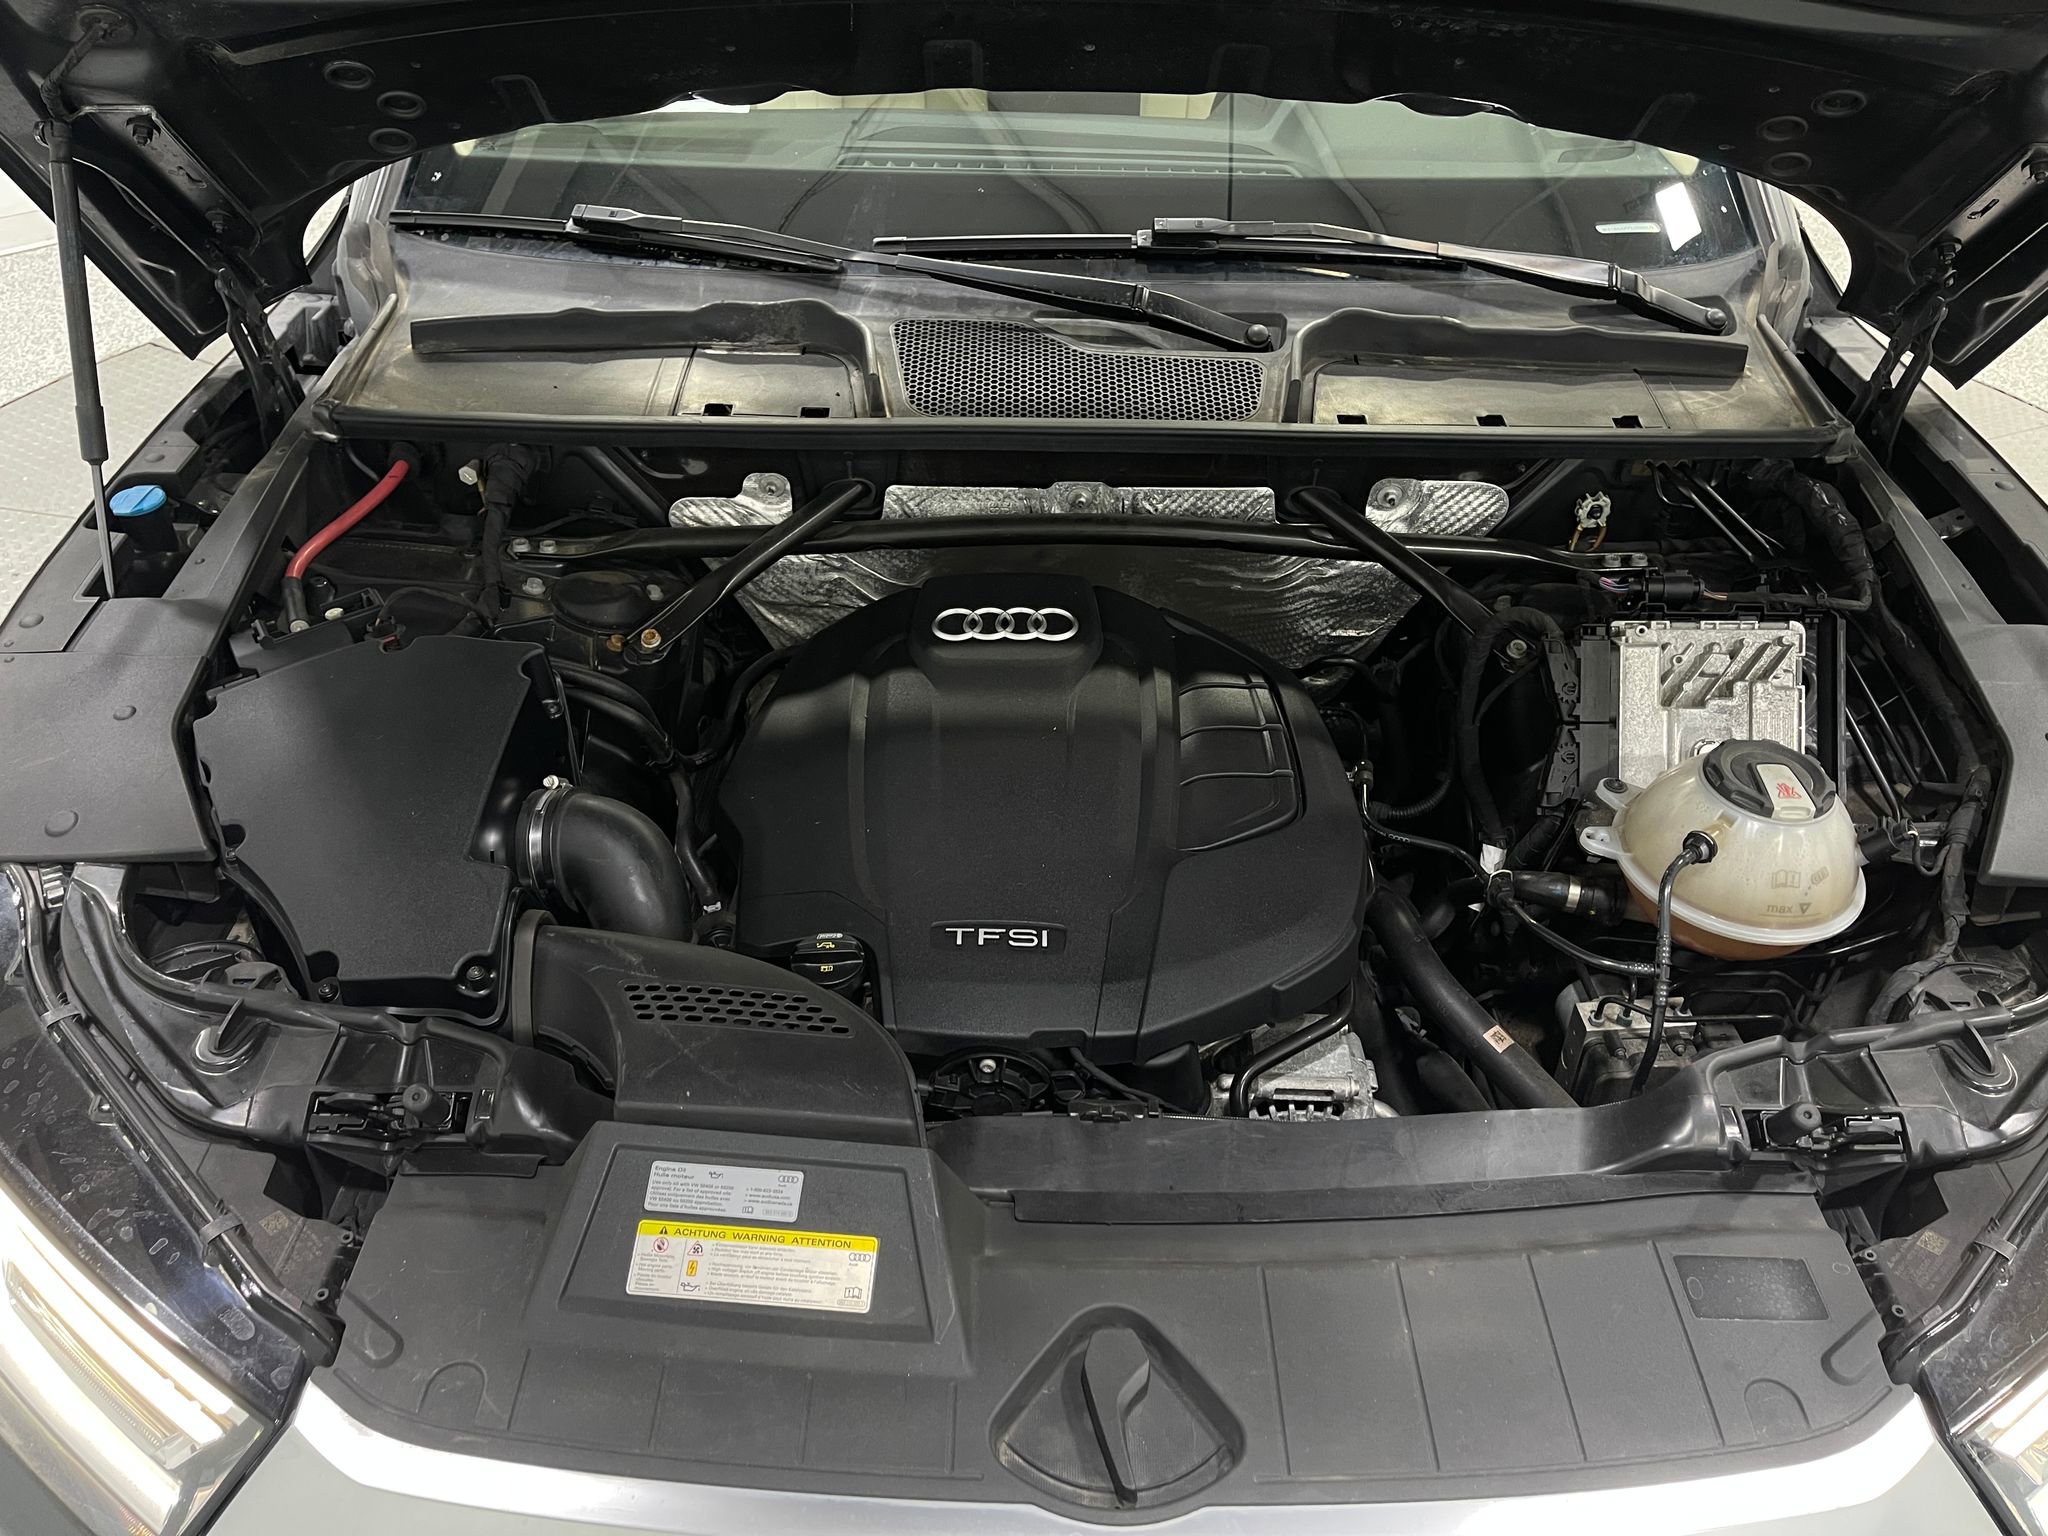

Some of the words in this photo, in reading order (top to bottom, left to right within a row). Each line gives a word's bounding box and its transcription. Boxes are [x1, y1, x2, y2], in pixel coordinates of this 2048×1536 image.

[1766, 904, 1793, 913] max
[945, 928, 1047, 947] TFSI
[674, 1228, 726, 1239] ACHTUNG
[732, 1232, 785, 1243] WARNING
[792, 1237, 851, 1248] ATTENTION
